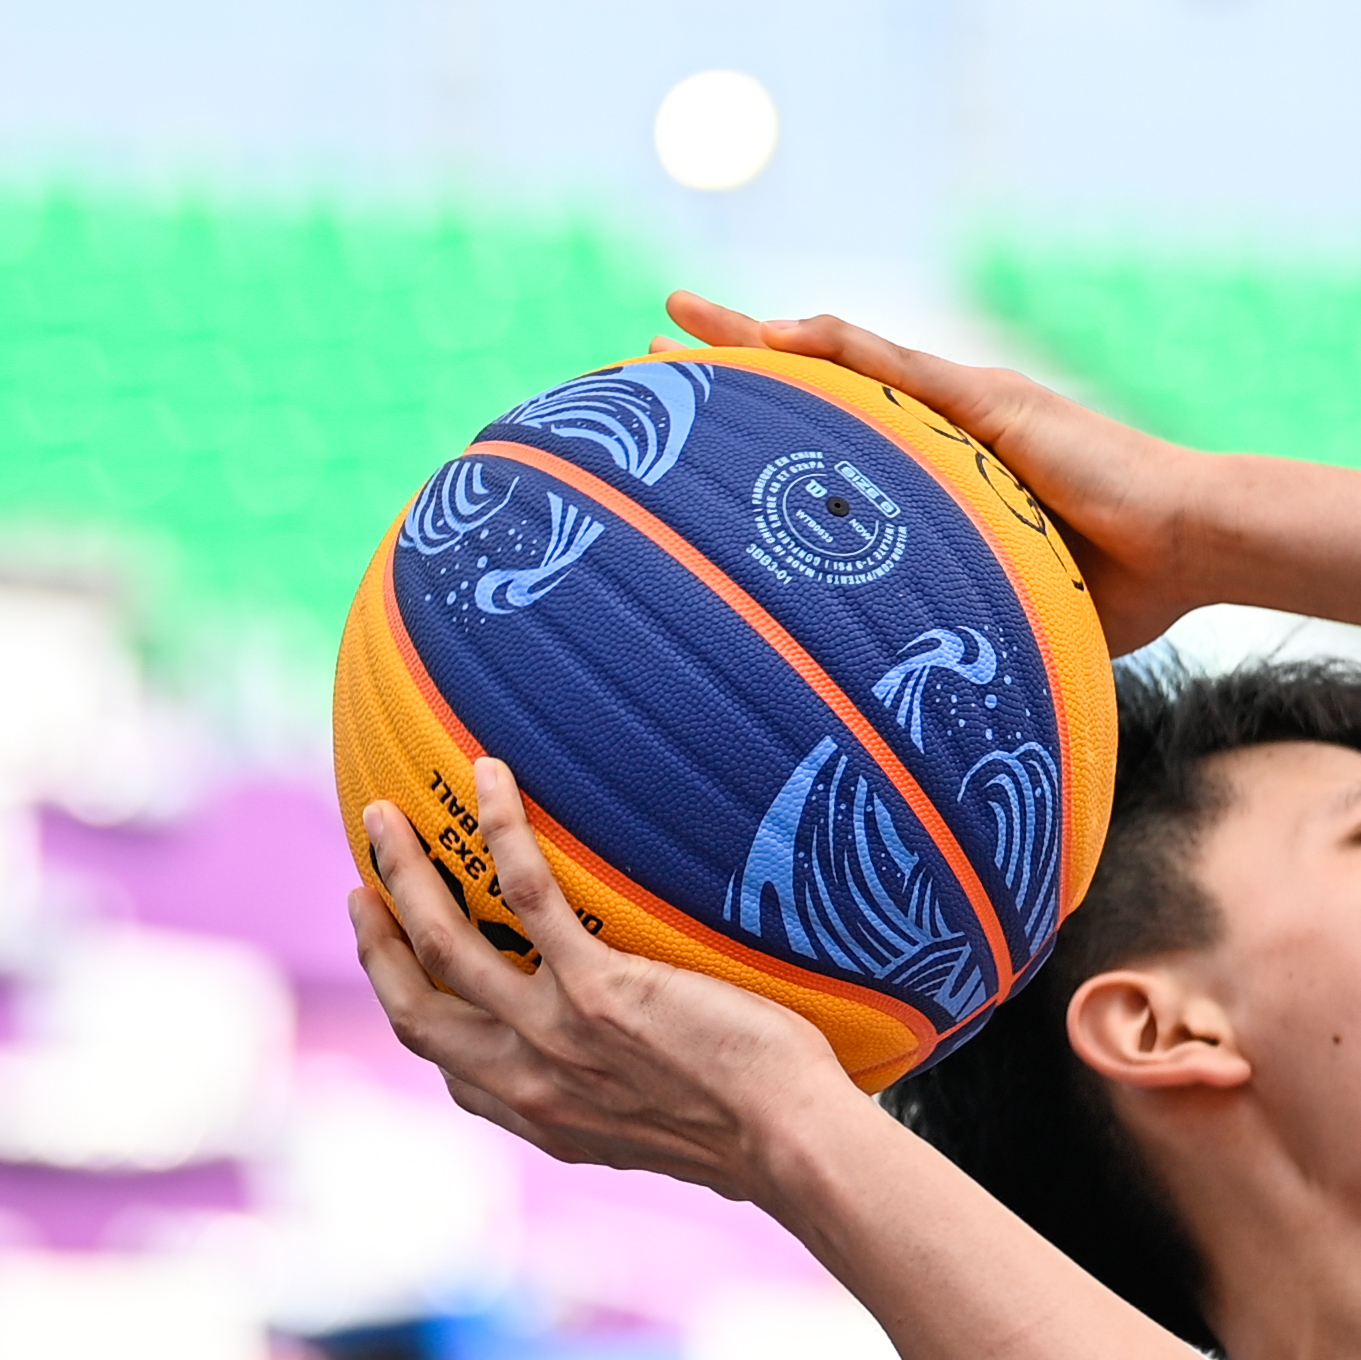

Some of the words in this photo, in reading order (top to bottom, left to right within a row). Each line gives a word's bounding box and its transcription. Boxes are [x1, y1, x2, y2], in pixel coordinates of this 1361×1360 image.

[841, 466, 880, 500] SIZE
[880, 501, 895, 514] 6
[772, 545, 786, 556] IN
[429, 769, 479, 836] BALL
